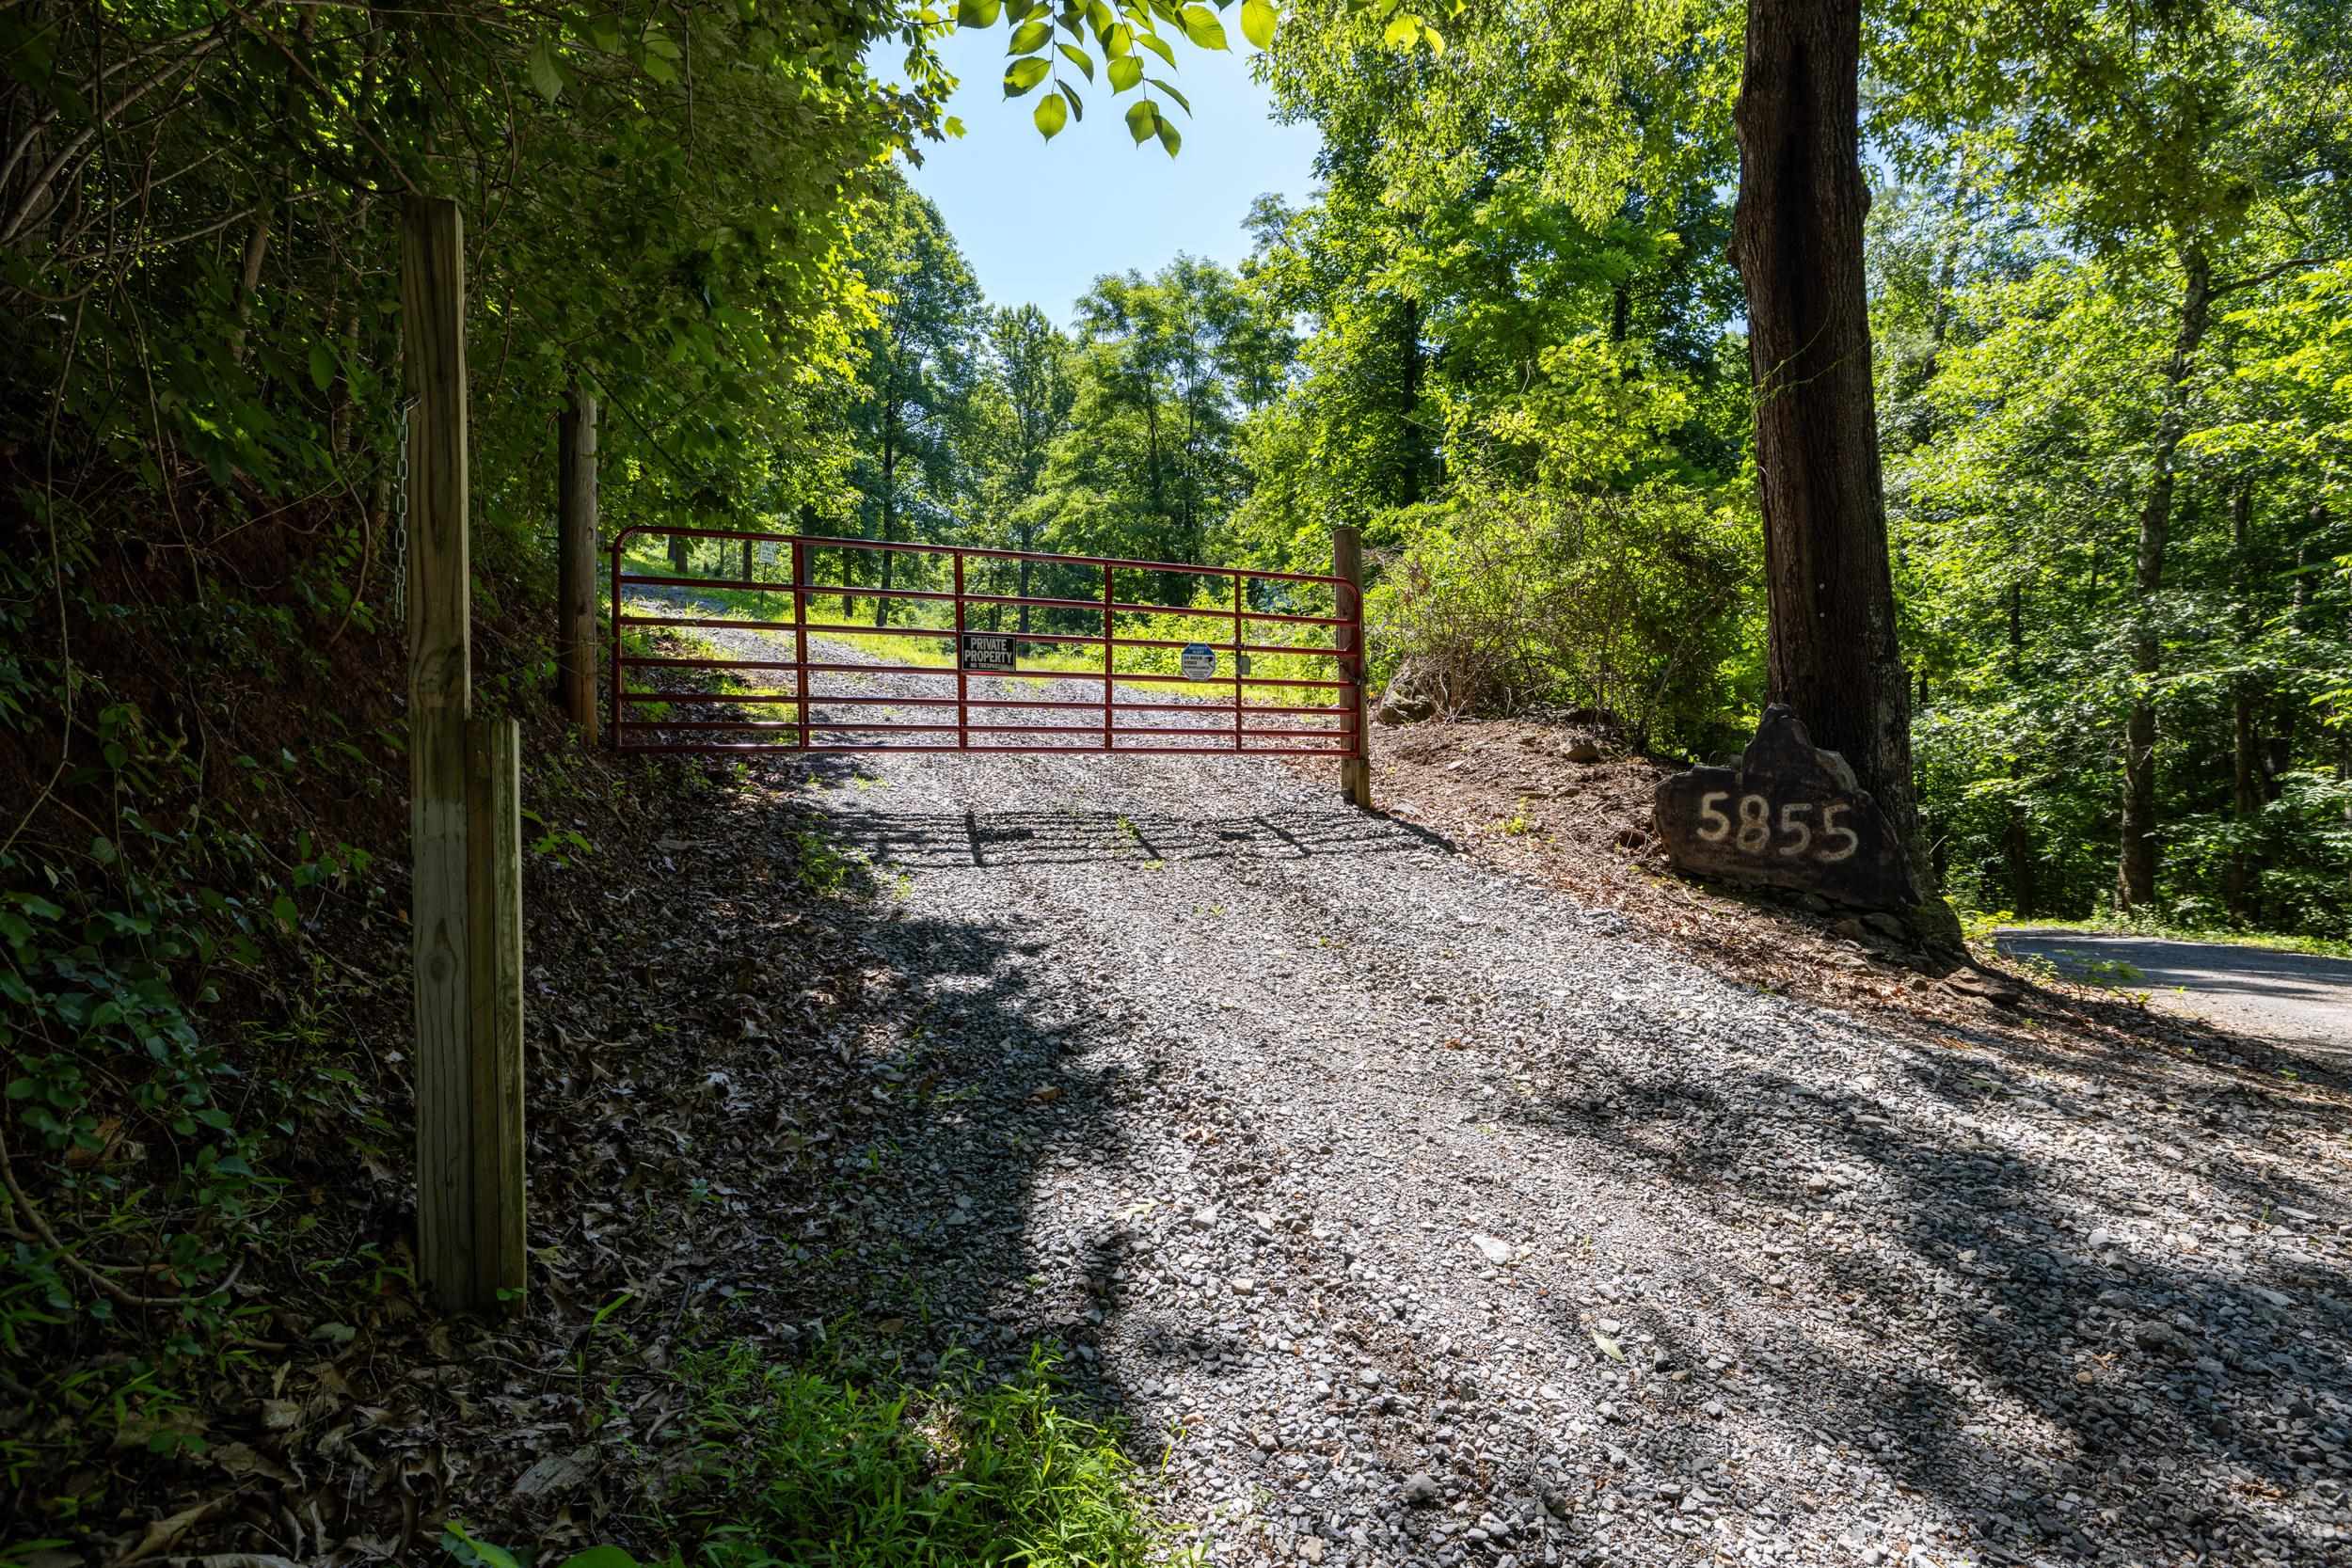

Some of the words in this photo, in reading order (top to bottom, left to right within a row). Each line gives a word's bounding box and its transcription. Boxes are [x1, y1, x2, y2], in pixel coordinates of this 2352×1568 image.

[970, 638, 1007, 651] PRIVATE
[964, 649, 1012, 663] PROPERTY
[1695, 791, 1859, 863] 5855
